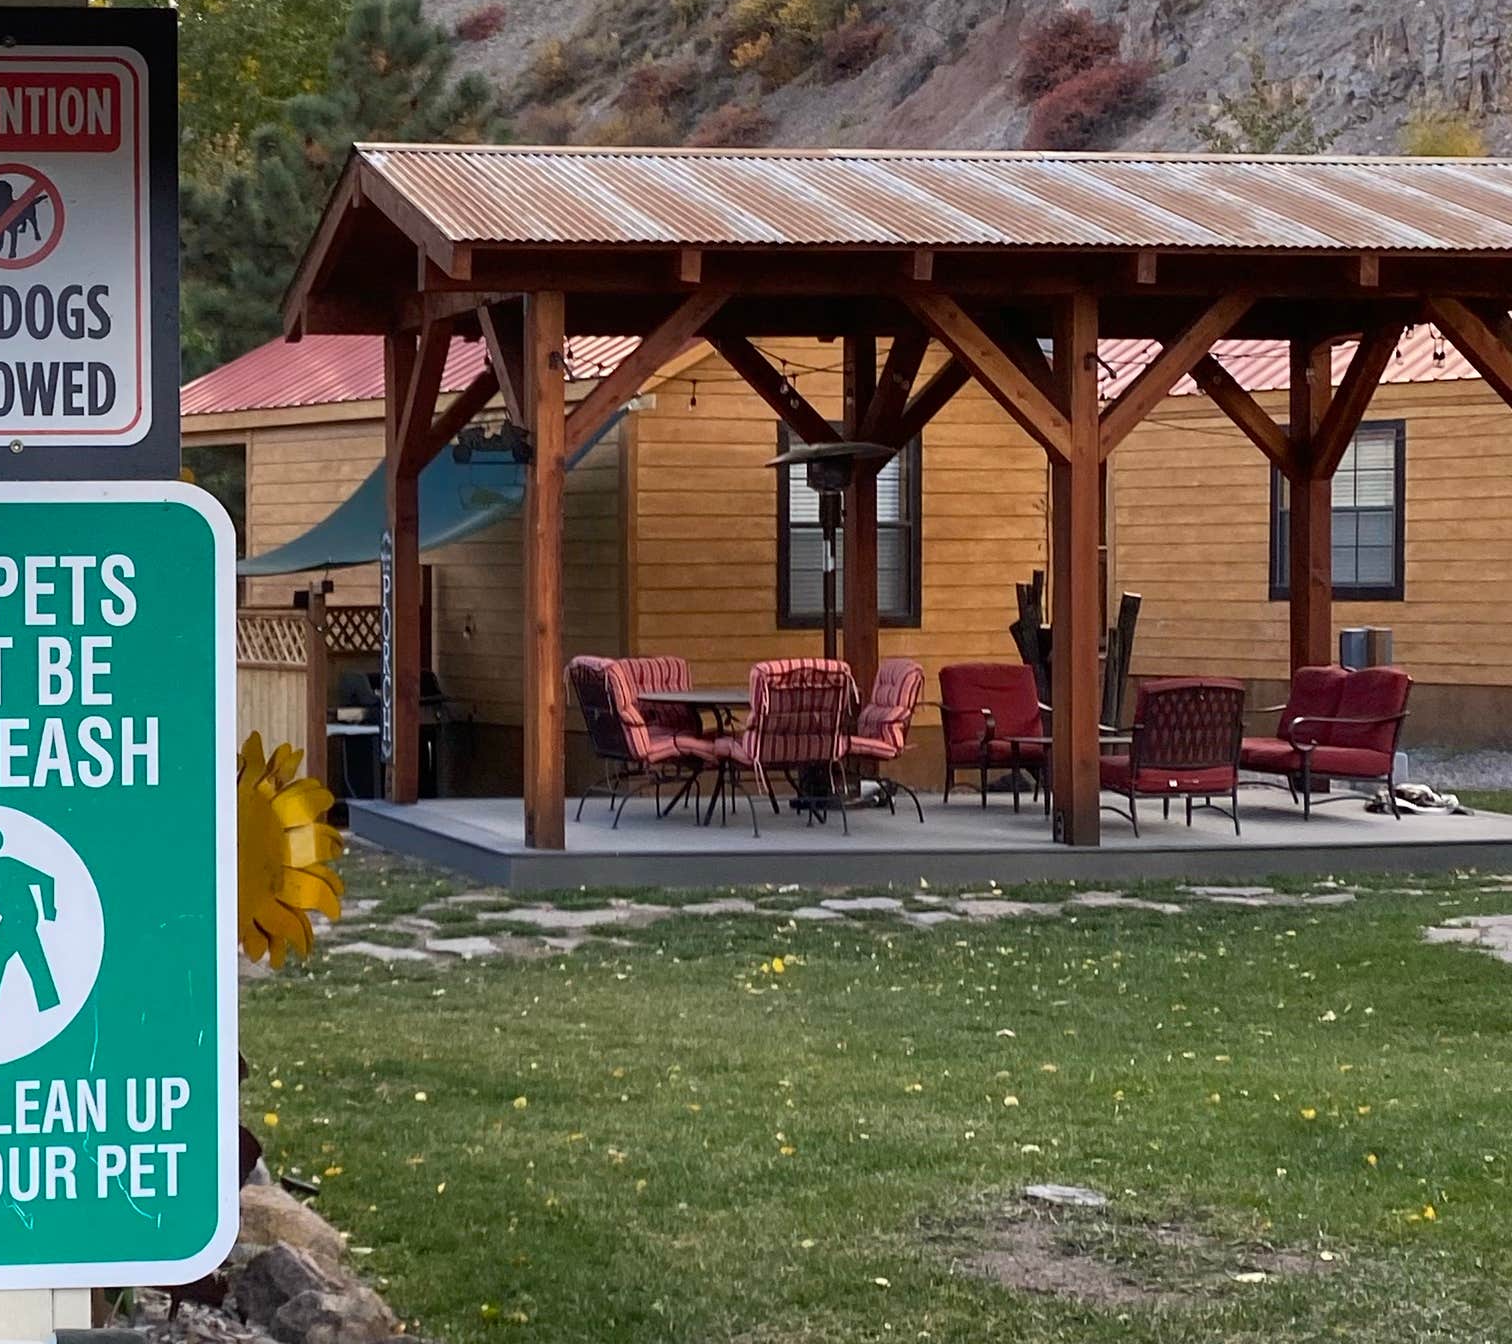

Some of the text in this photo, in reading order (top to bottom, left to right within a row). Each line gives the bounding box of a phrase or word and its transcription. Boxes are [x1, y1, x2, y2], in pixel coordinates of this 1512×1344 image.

[38, 635, 114, 706] BE
[381, 574, 392, 742] PORCH
[126, 1077, 190, 1133] UP
[97, 1144, 187, 1199] PET
